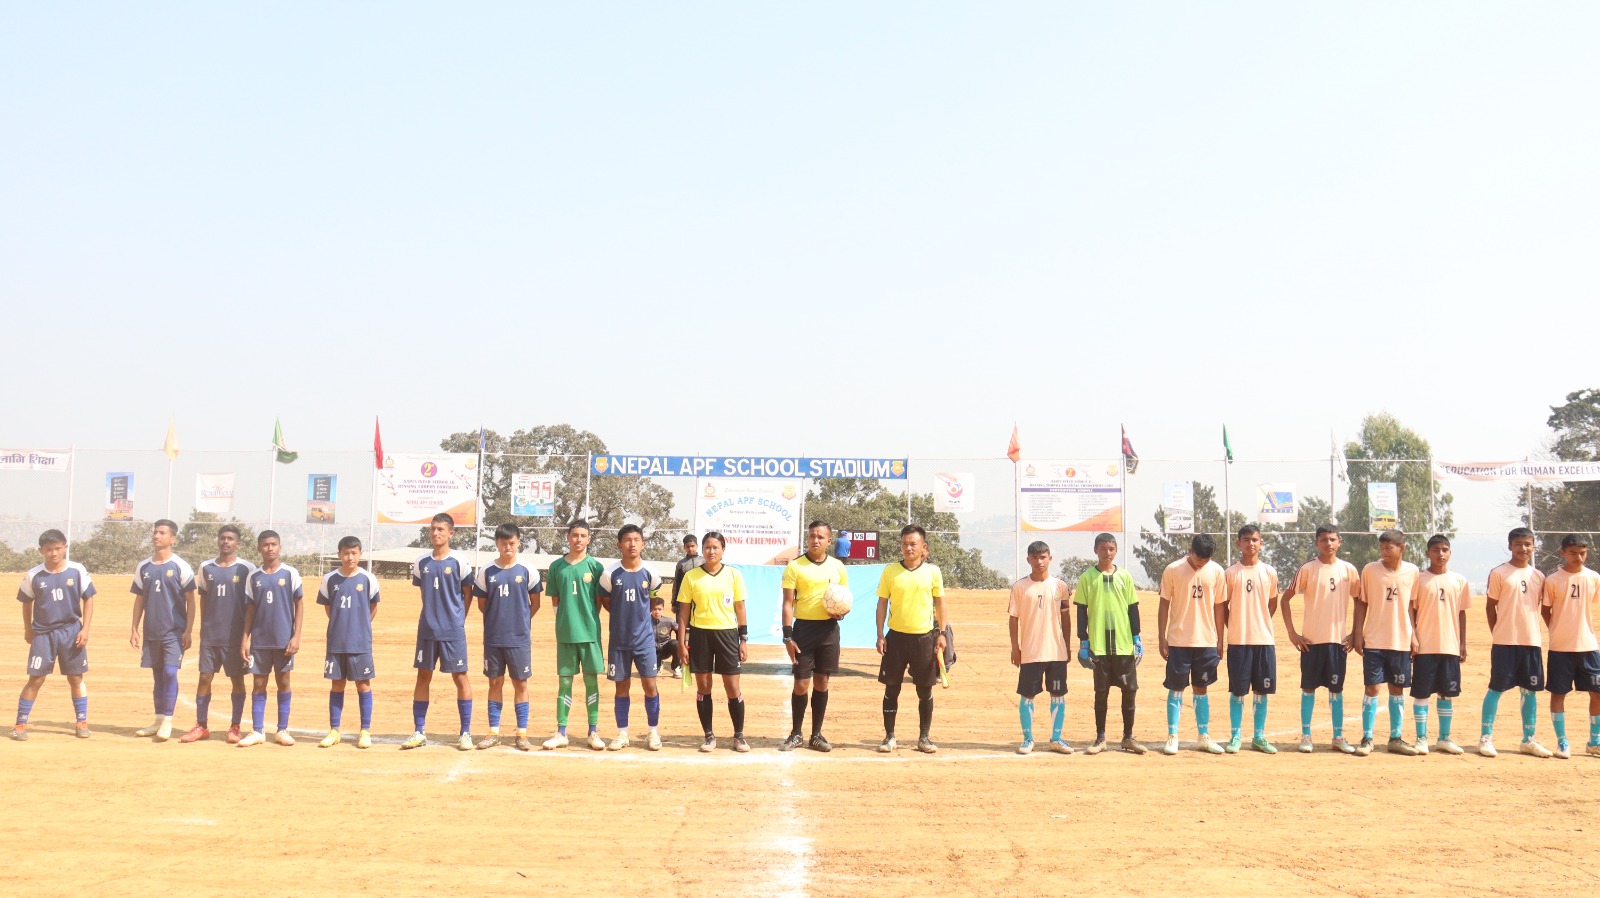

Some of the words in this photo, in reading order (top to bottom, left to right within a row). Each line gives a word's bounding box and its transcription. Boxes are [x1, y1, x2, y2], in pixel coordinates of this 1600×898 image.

[610, 457, 674, 475] NEPAL
[680, 458, 717, 475] APF
[723, 458, 805, 477] SCHOOL
[809, 459, 890, 478] STADIUM
[1500, 466, 1518, 475] FOR
[1521, 466, 1556, 475] HUMAN
[706, 498, 735, 517] NEPAL
[737, 496, 756, 505] APF
[757, 498, 792, 521] SCHOOL
[724, 536, 743, 544] NING
[745, 537, 787, 546] CEREMONY
[154, 579, 162, 592] 2
[433, 576, 440, 589] 4
[572, 580, 578, 595] 1
[1246, 579, 1253, 592] 8
[1329, 577, 1336, 592] 3
[1521, 580, 1527, 594] 9
[51, 587, 64, 601] 10
[216, 583, 227, 597] 11
[498, 583, 510, 596] 14
[624, 588, 636, 602] 13
[1191, 584, 1204, 599] 29
[1439, 587, 1445, 602] 2
[1570, 584, 1580, 599] 21
[267, 590, 275, 604] 9
[340, 595, 352, 608] 21
[30, 655, 43, 669] 10
[416, 649, 423, 663] 4
[1121, 674, 1128, 685] 1
[1201, 671, 1208, 682] 4
[1263, 677, 1271, 688] 6
[1330, 674, 1339, 684] 3
[1529, 675, 1538, 686] 9
[1052, 679, 1061, 690] 11
[1449, 680, 1458, 692] 2
